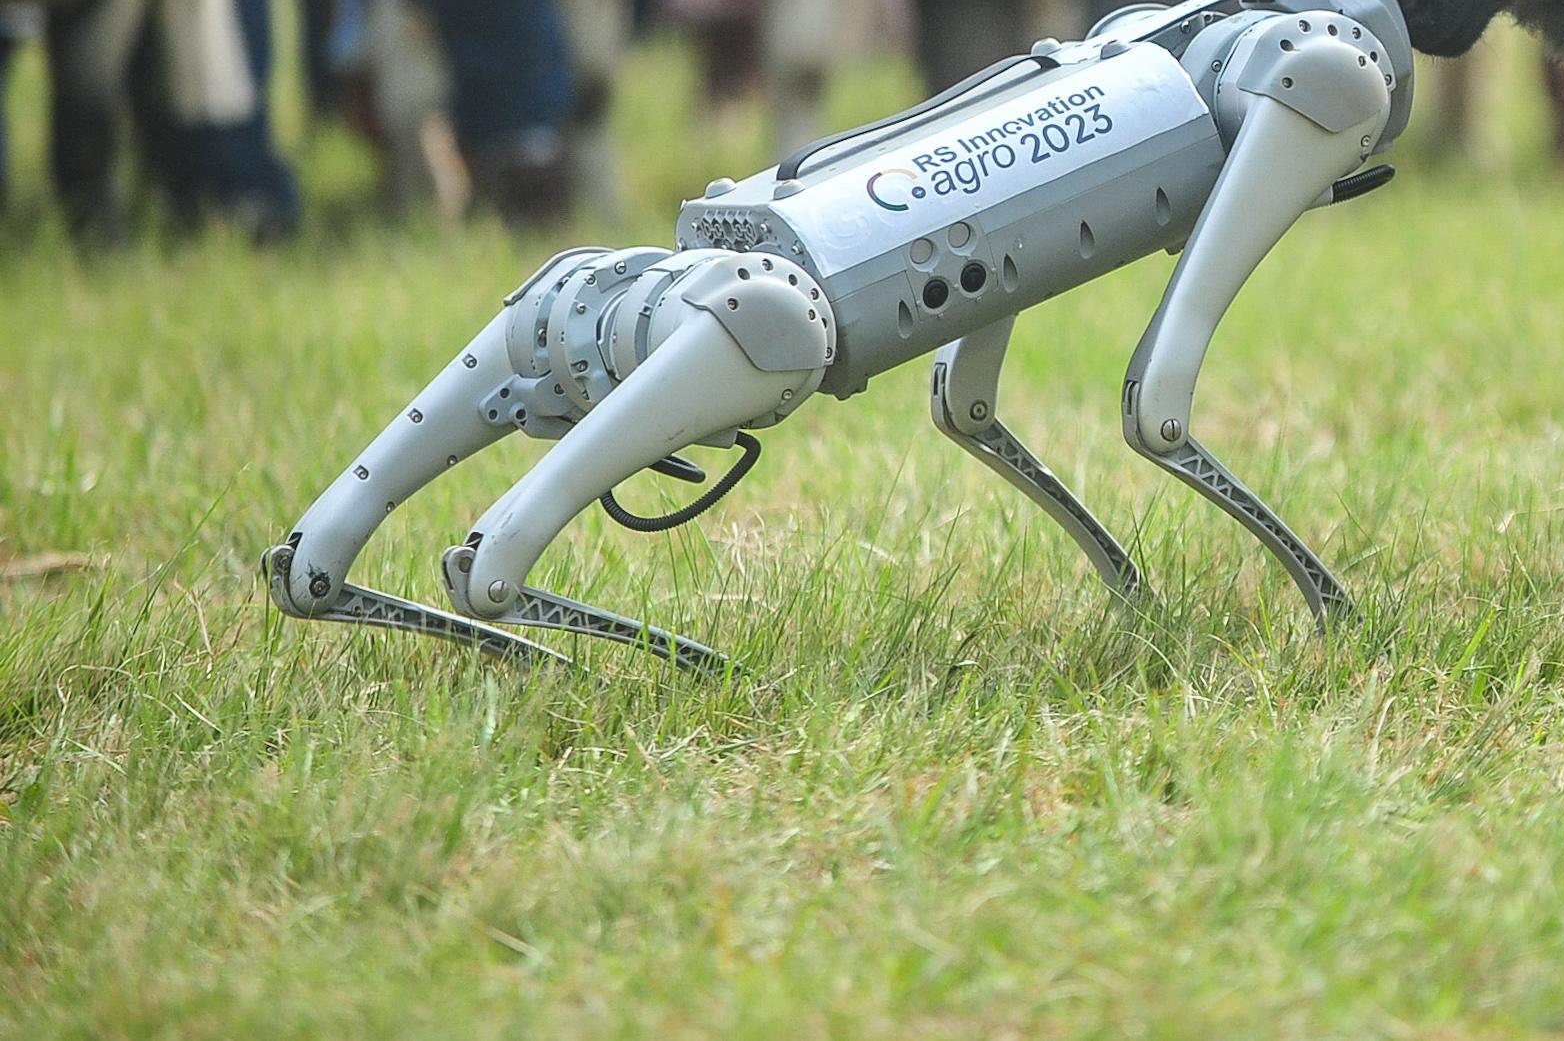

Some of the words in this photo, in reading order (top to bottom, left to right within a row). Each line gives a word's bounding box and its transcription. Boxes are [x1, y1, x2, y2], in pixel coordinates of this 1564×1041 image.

[912, 146, 957, 173] RS
[958, 85, 1105, 151] Innovation
[931, 144, 1016, 194] agro
[1020, 103, 1113, 164] 2023
